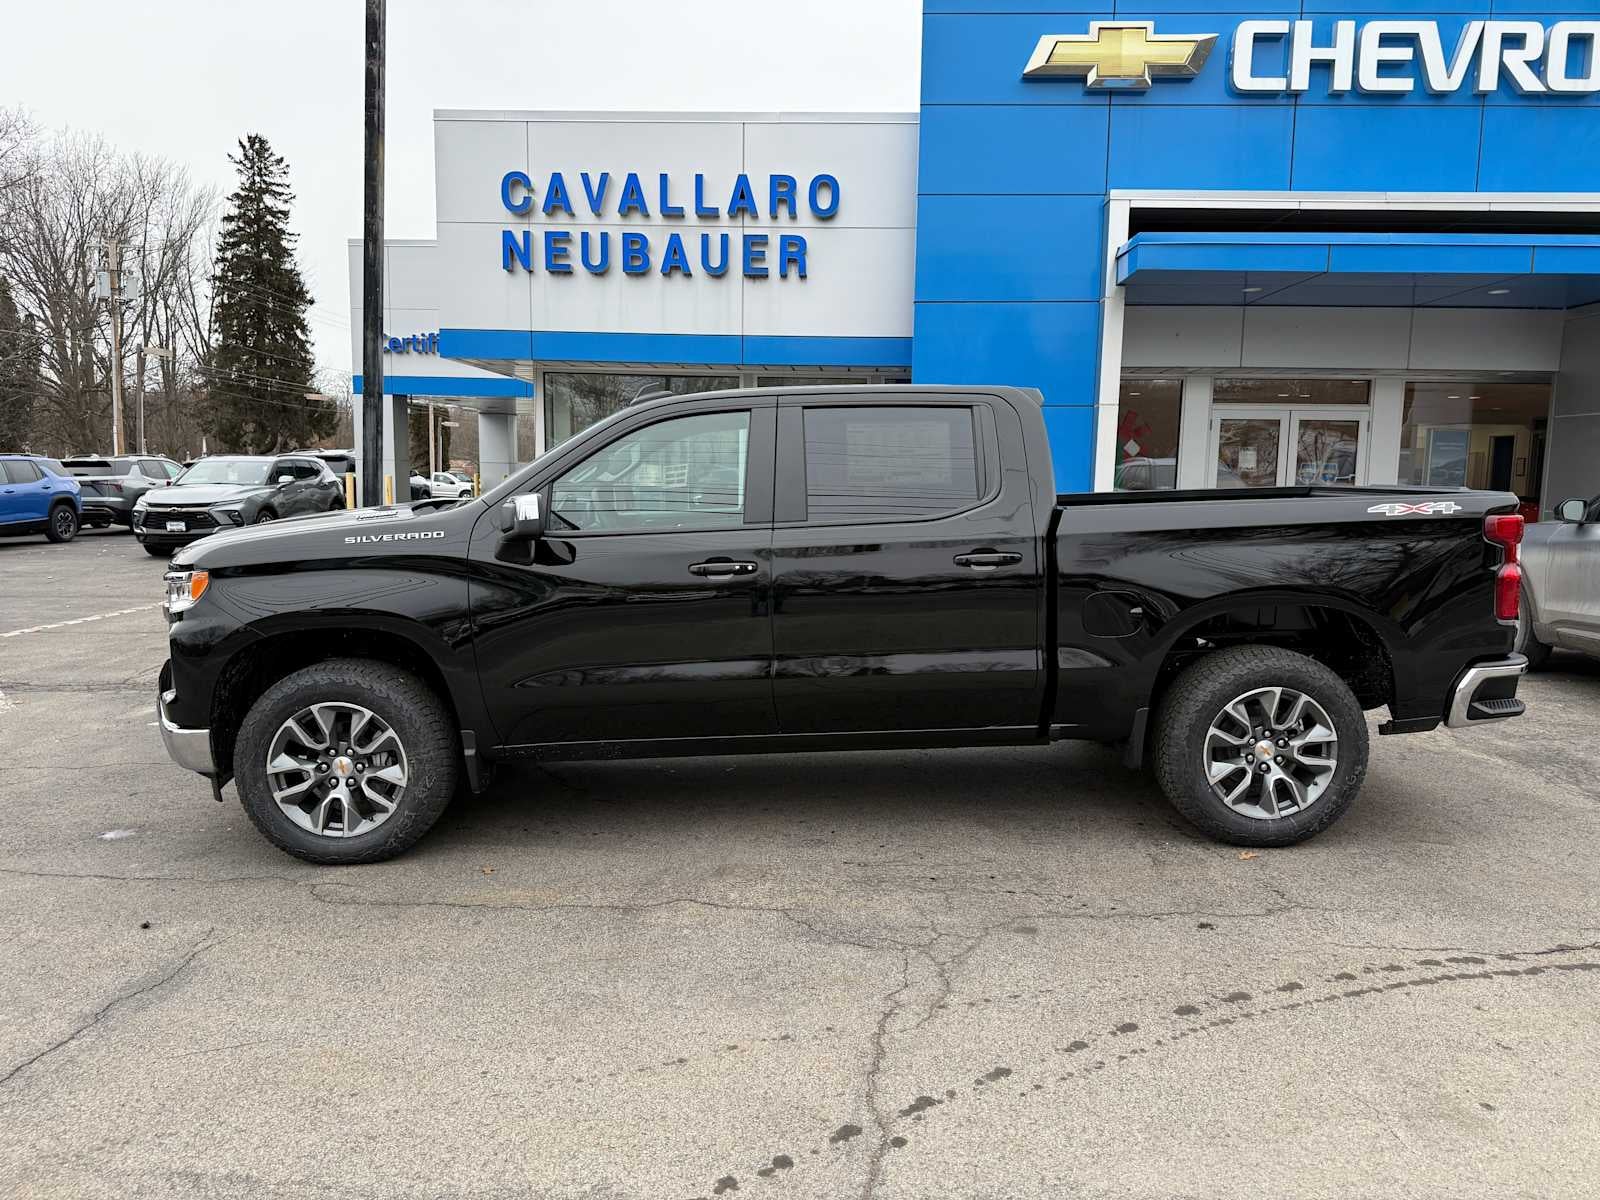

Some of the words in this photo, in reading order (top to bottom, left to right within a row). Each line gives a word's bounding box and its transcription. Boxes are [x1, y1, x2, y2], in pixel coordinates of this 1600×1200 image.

[1230, 20, 1600, 94] CHEVRO
[501, 171, 840, 220] CAVALLARO
[502, 230, 807, 278] NEUBAUER
[344, 530, 445, 544] SILVERADO
